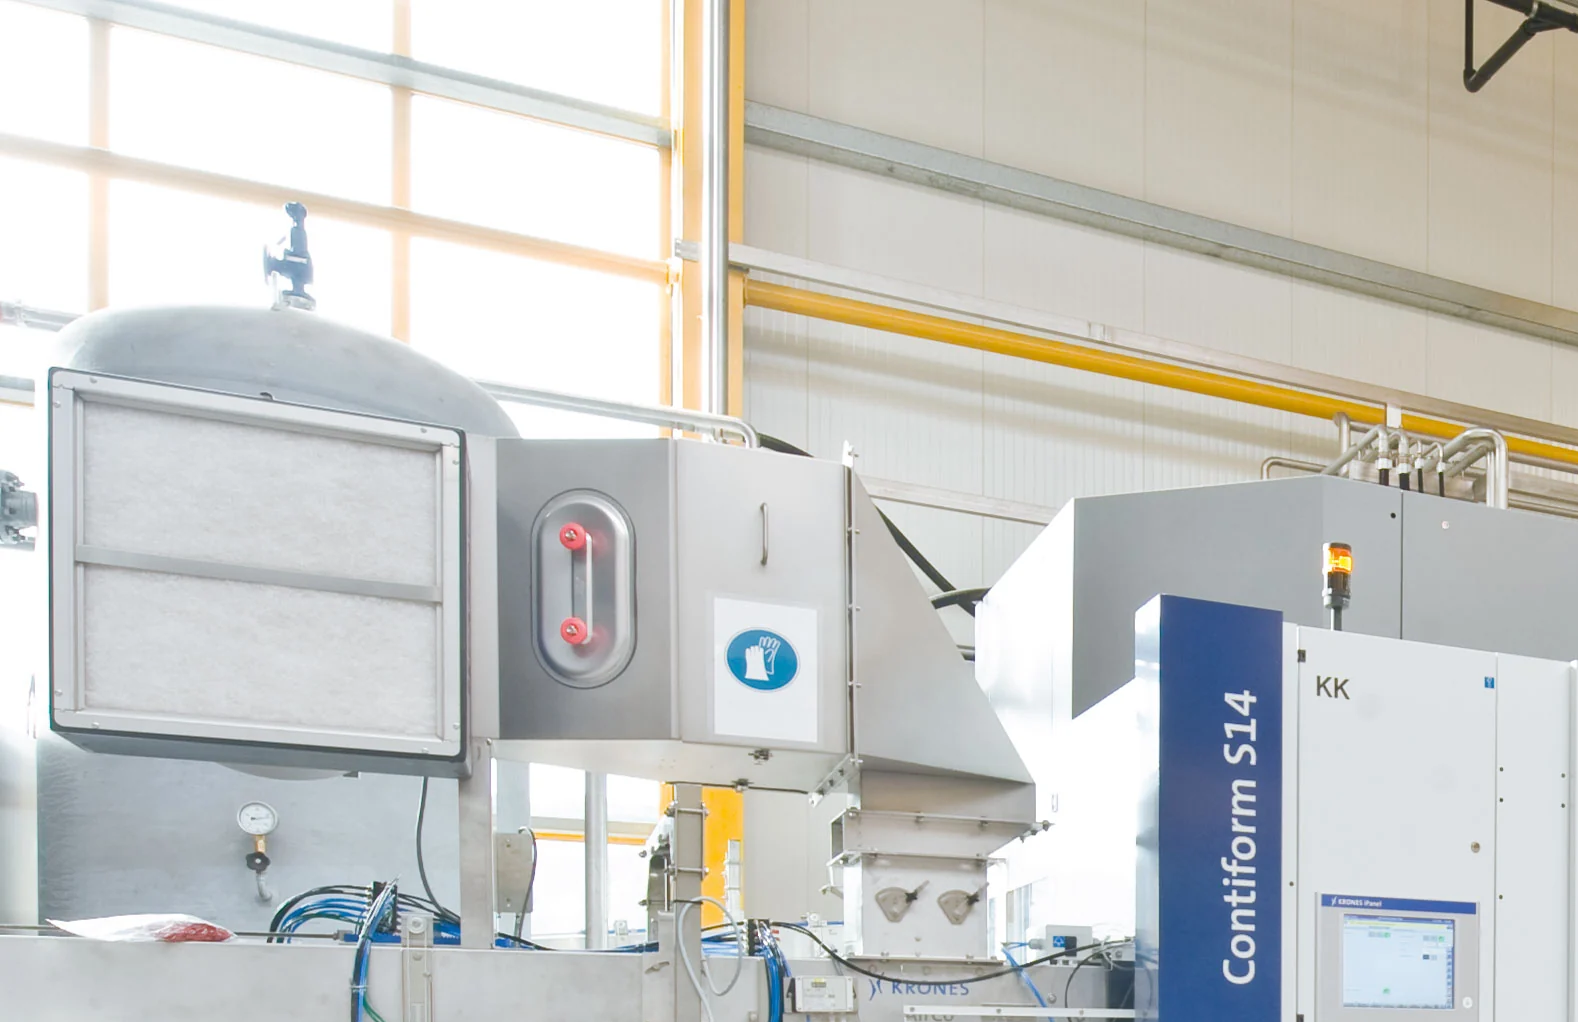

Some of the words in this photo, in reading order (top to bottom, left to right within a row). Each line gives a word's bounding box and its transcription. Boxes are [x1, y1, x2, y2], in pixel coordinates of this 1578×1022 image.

[1316, 675, 1350, 700] KK
[1223, 690, 1258, 766] S14
[1221, 778, 1257, 985] Contiform
[1338, 898, 1363, 906] KRONES
[892, 980, 969, 996] KRONES
